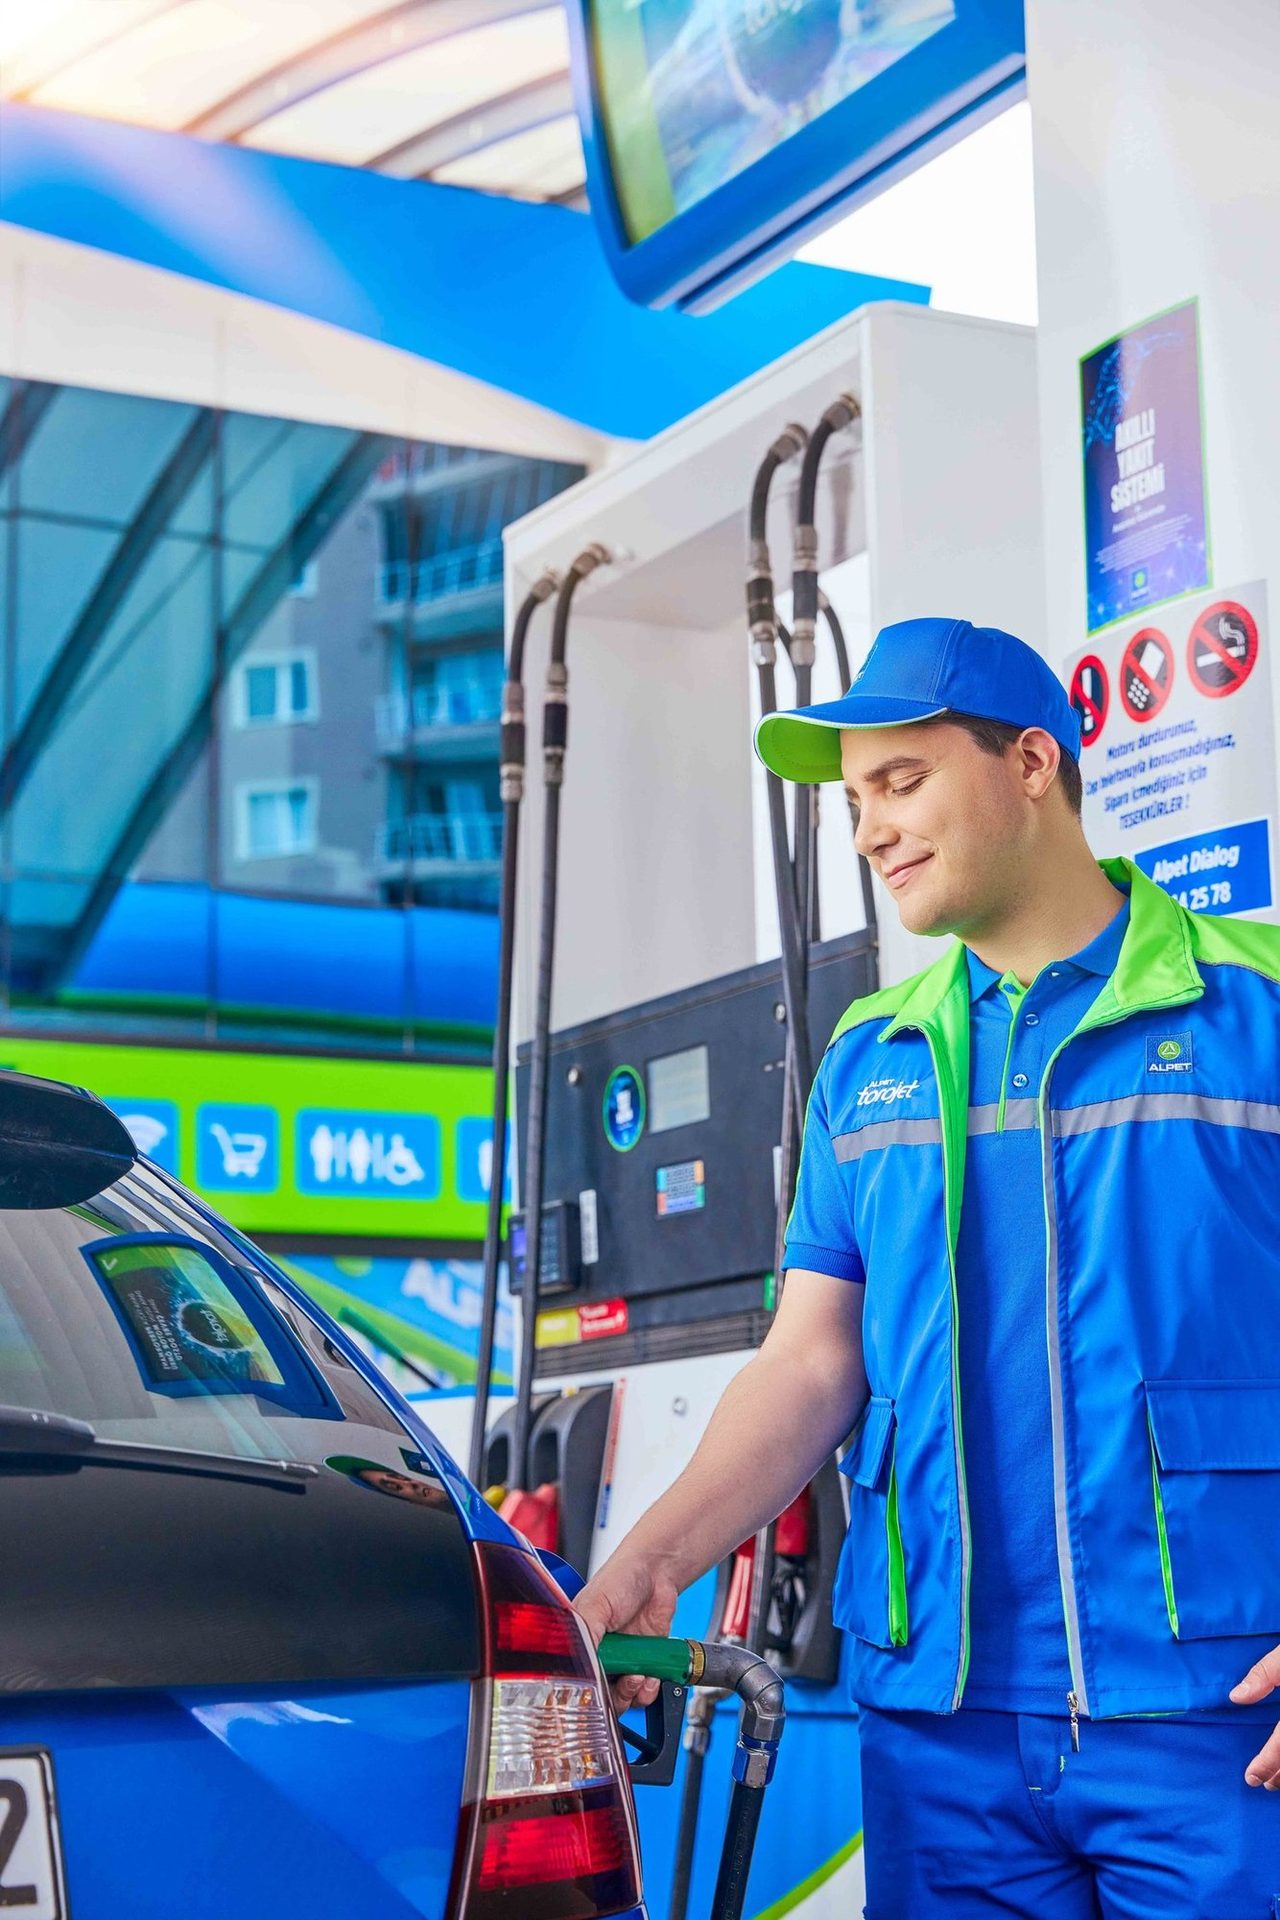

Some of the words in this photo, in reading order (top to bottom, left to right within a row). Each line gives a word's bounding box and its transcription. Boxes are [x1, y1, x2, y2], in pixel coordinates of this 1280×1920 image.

[1152, 854, 1189, 884] Alpet
[1189, 844, 1240, 873] Dialog
[1189, 885, 1209, 911] 25
[1210, 880, 1232, 906] 78
[1149, 1062, 1192, 1072] ALPET
